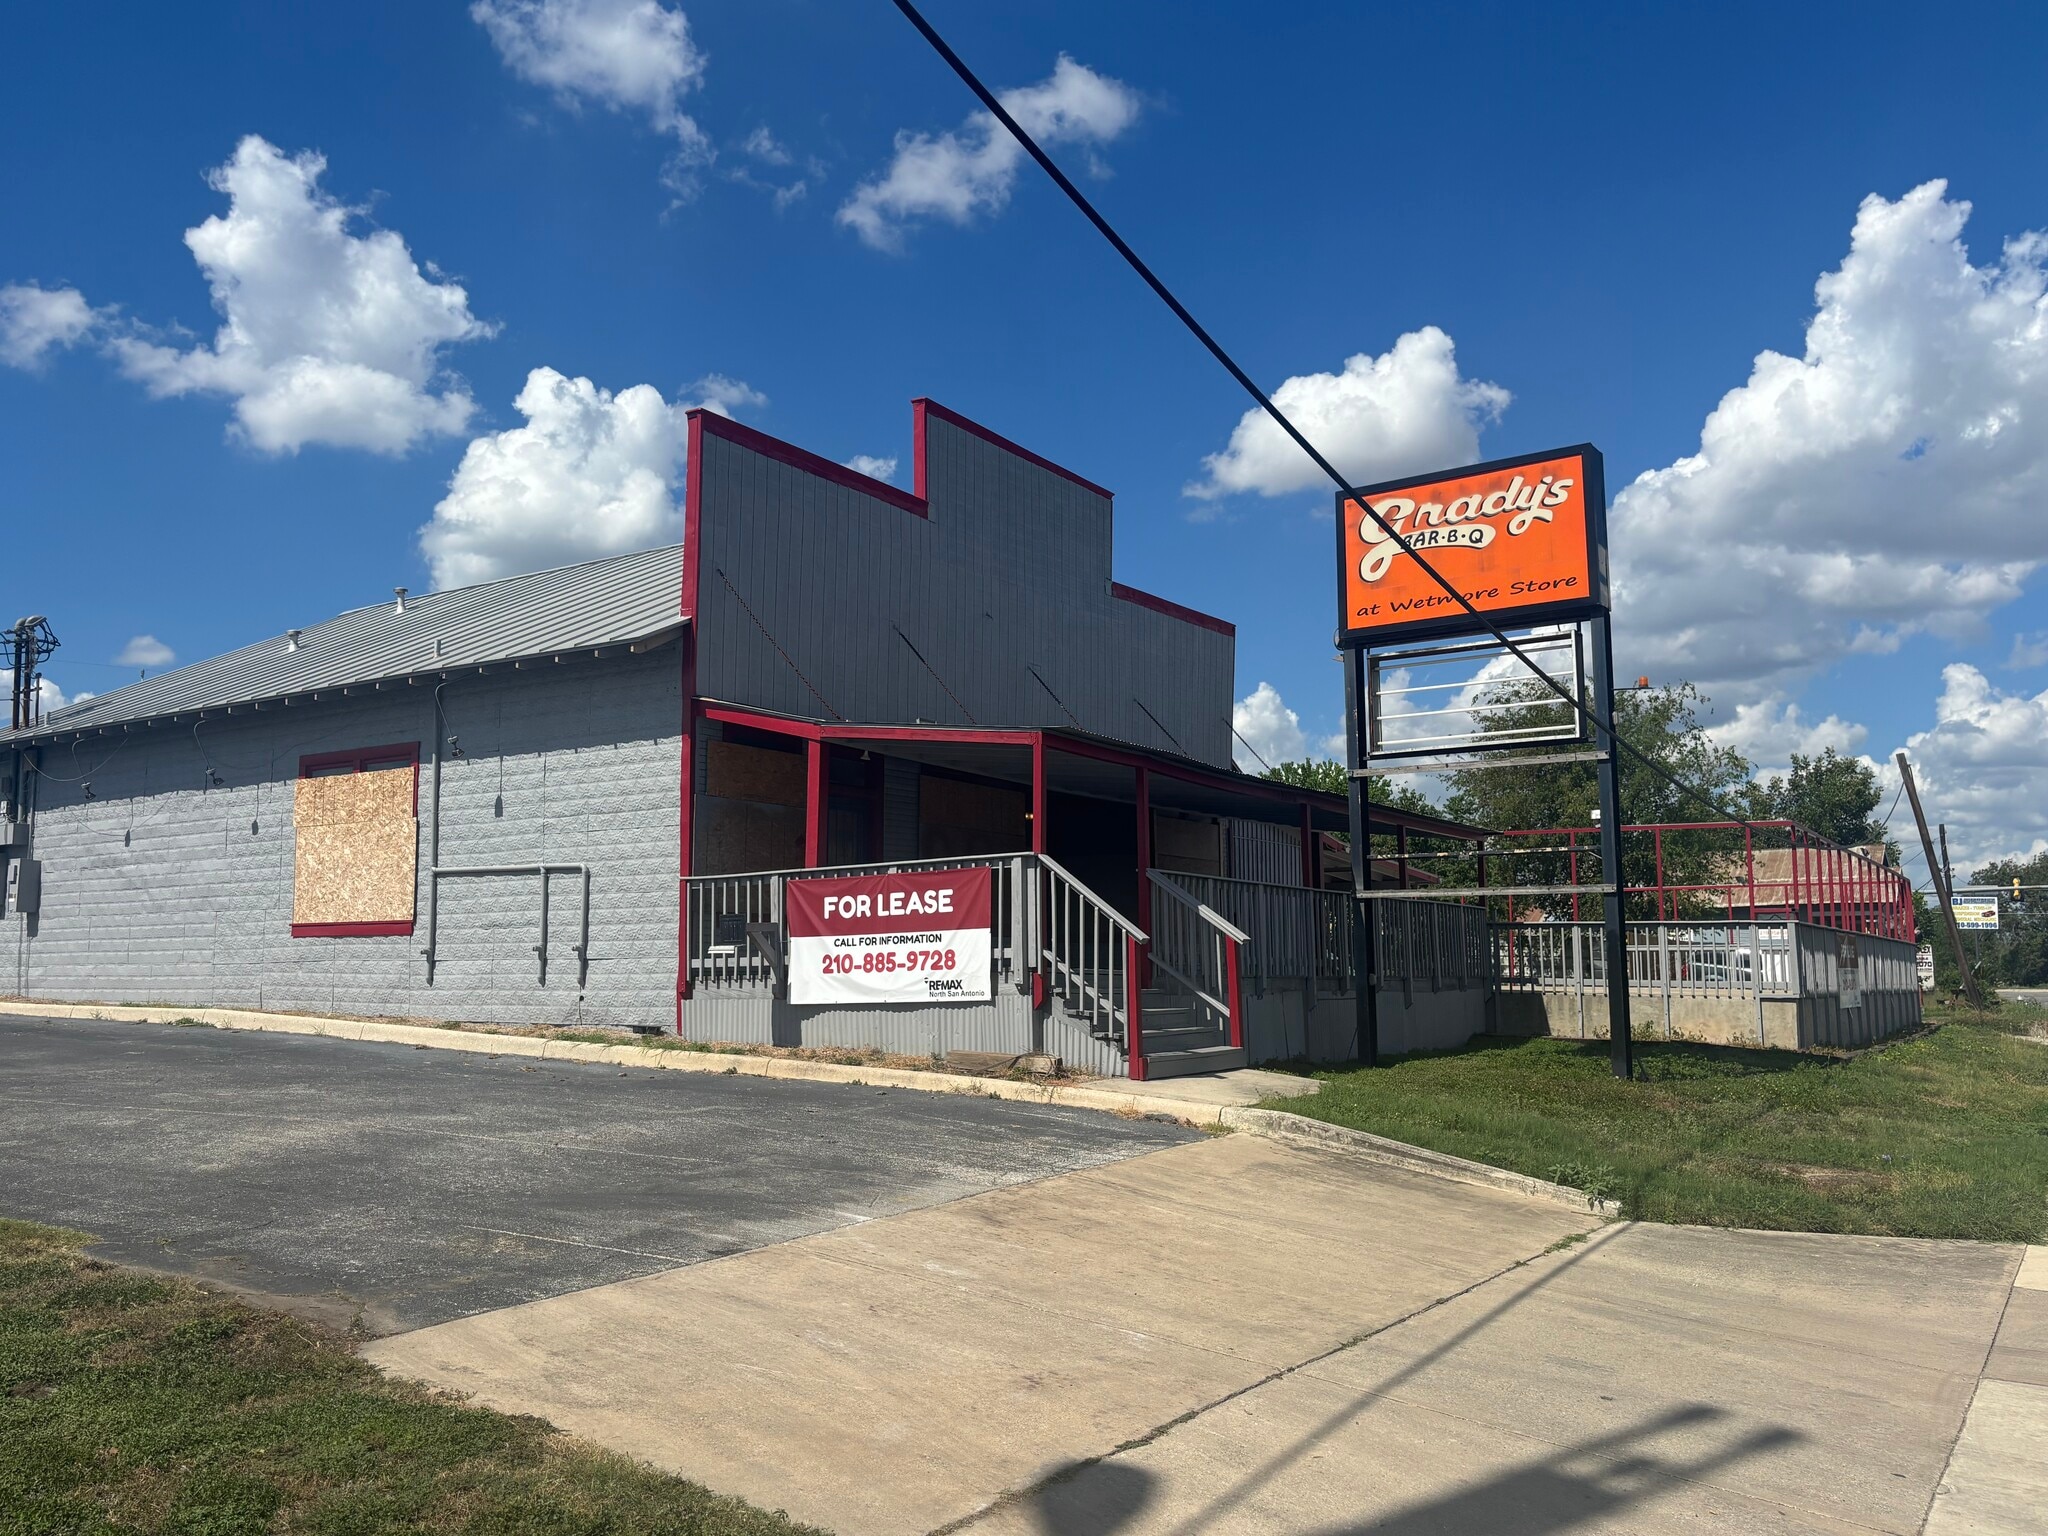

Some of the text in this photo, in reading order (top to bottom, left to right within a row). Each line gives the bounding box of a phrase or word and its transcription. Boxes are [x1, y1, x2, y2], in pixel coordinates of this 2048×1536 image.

[1356, 575, 1578, 617] at Wetmore Store
[823, 889, 954, 920] FOR LEASE
[834, 934, 942, 947] CALL FOR INFORMATION
[822, 949, 956, 974] 210-885-9728
